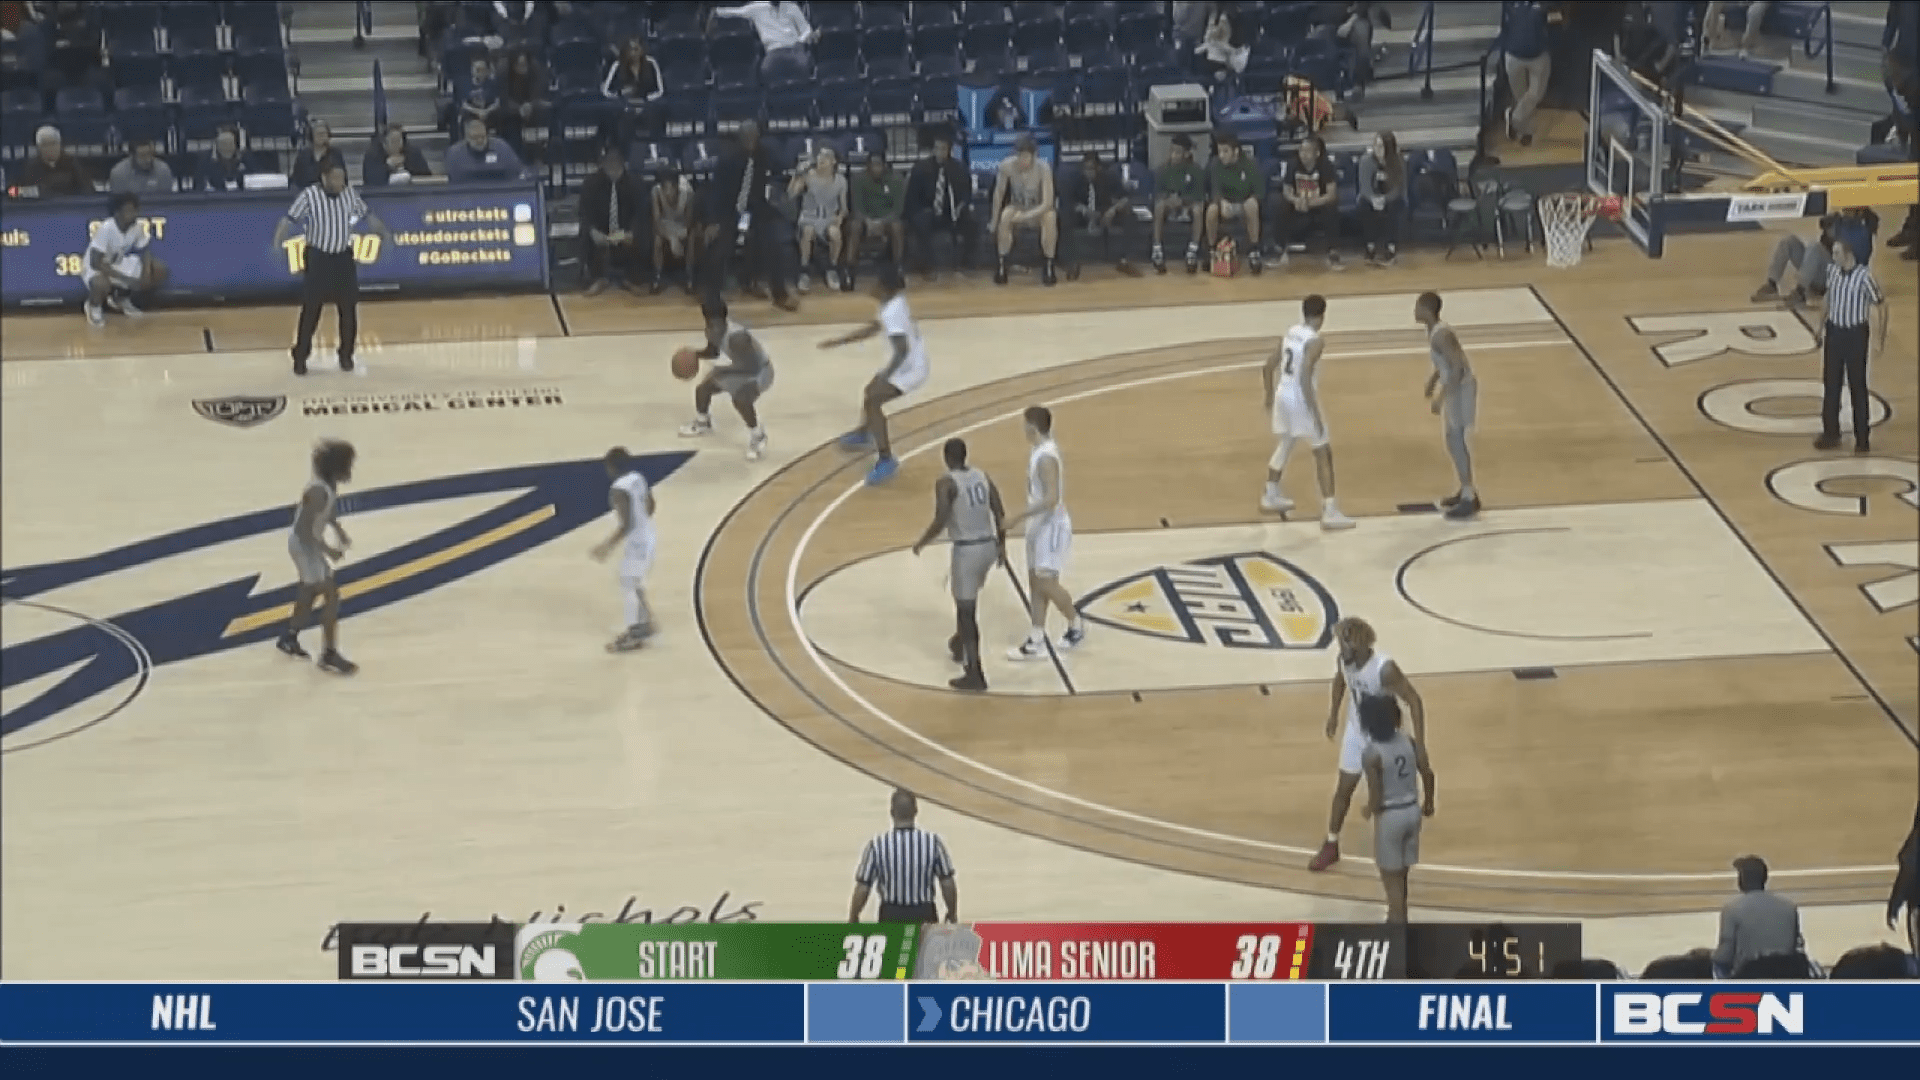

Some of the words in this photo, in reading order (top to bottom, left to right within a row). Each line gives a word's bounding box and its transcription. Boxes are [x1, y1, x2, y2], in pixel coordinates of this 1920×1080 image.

[55, 253, 82, 275] 38
[967, 480, 987, 507] 10
[1395, 755, 1410, 777] 2
